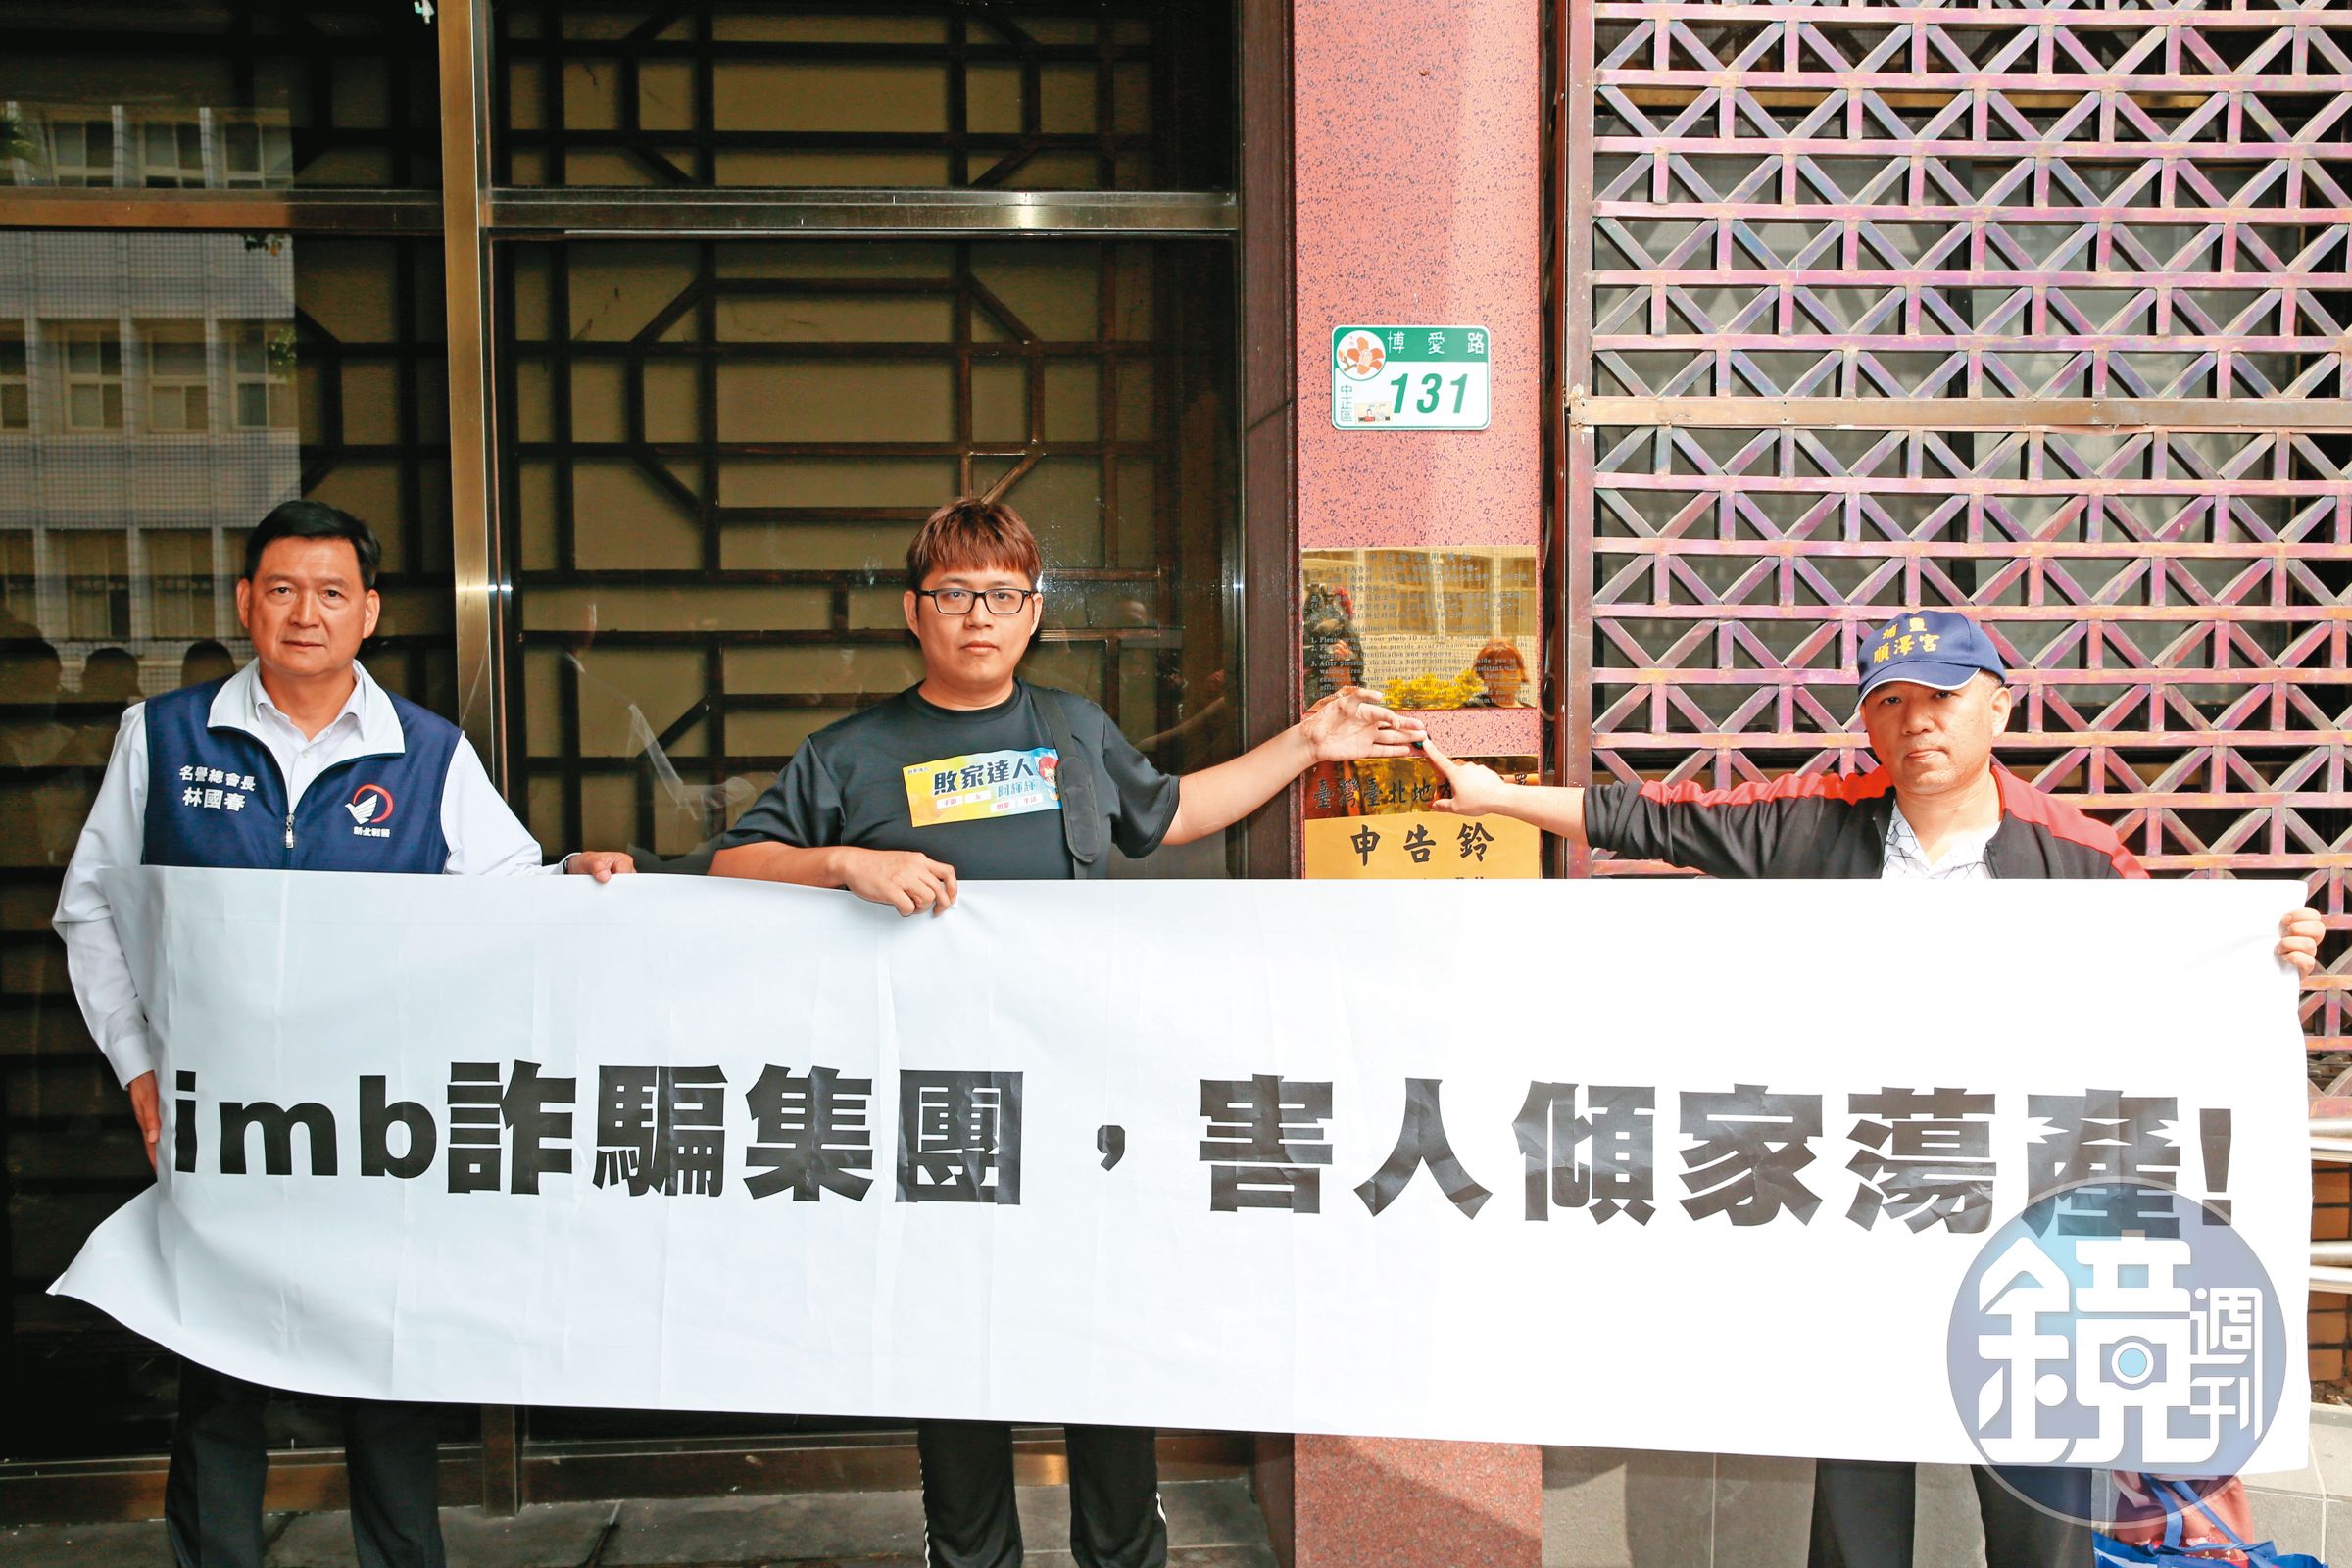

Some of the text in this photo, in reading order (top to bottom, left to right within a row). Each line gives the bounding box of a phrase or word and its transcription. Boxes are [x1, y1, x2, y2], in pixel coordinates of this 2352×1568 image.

[1388, 331, 1485, 354] 博愛路
[1340, 385, 1353, 422] 中正區
[1390, 373, 1468, 414] 131
[1873, 633, 1940, 664] 順澤宮
[179, 764, 257, 791] 名譽總會長
[933, 758, 1034, 796] 敗家達人
[181, 787, 246, 812] 林國春
[1350, 822, 1495, 867] 申告鈴
